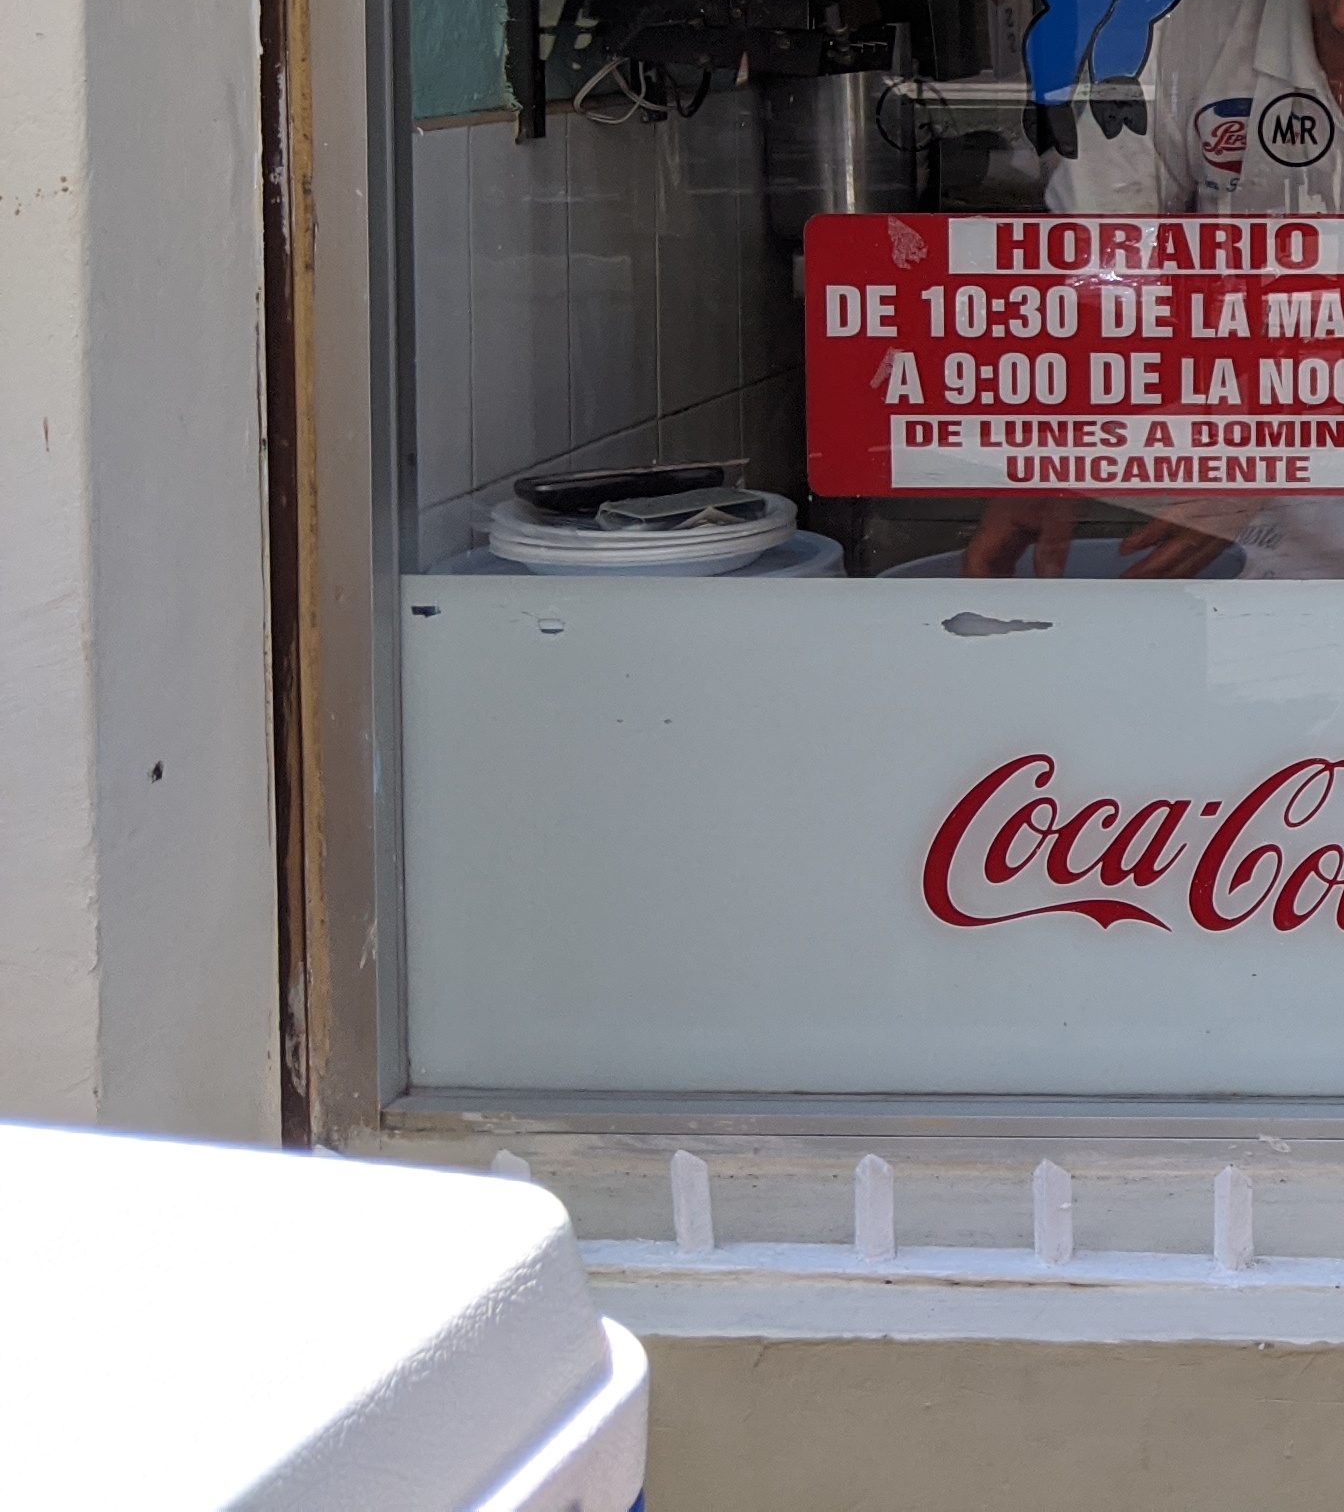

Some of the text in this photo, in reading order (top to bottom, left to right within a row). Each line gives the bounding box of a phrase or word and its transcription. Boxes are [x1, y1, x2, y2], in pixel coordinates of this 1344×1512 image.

[1272, 115, 1318, 145] MR
[996, 221, 1321, 272] HORARIO
[826, 284, 898, 338] DE
[920, 284, 1079, 338] 10:30
[1101, 284, 1174, 338] DE
[1190, 293, 1251, 338] LA
[885, 352, 925, 405] A
[944, 352, 1067, 405] 9:00
[1089, 352, 1163, 405] DE
[1180, 359, 1245, 405] LA
[905, 419, 963, 448] DE
[979, 419, 1129, 449] LUNES
[1143, 419, 1178, 449] A
[1005, 455, 1311, 484] UNICAMENTE
